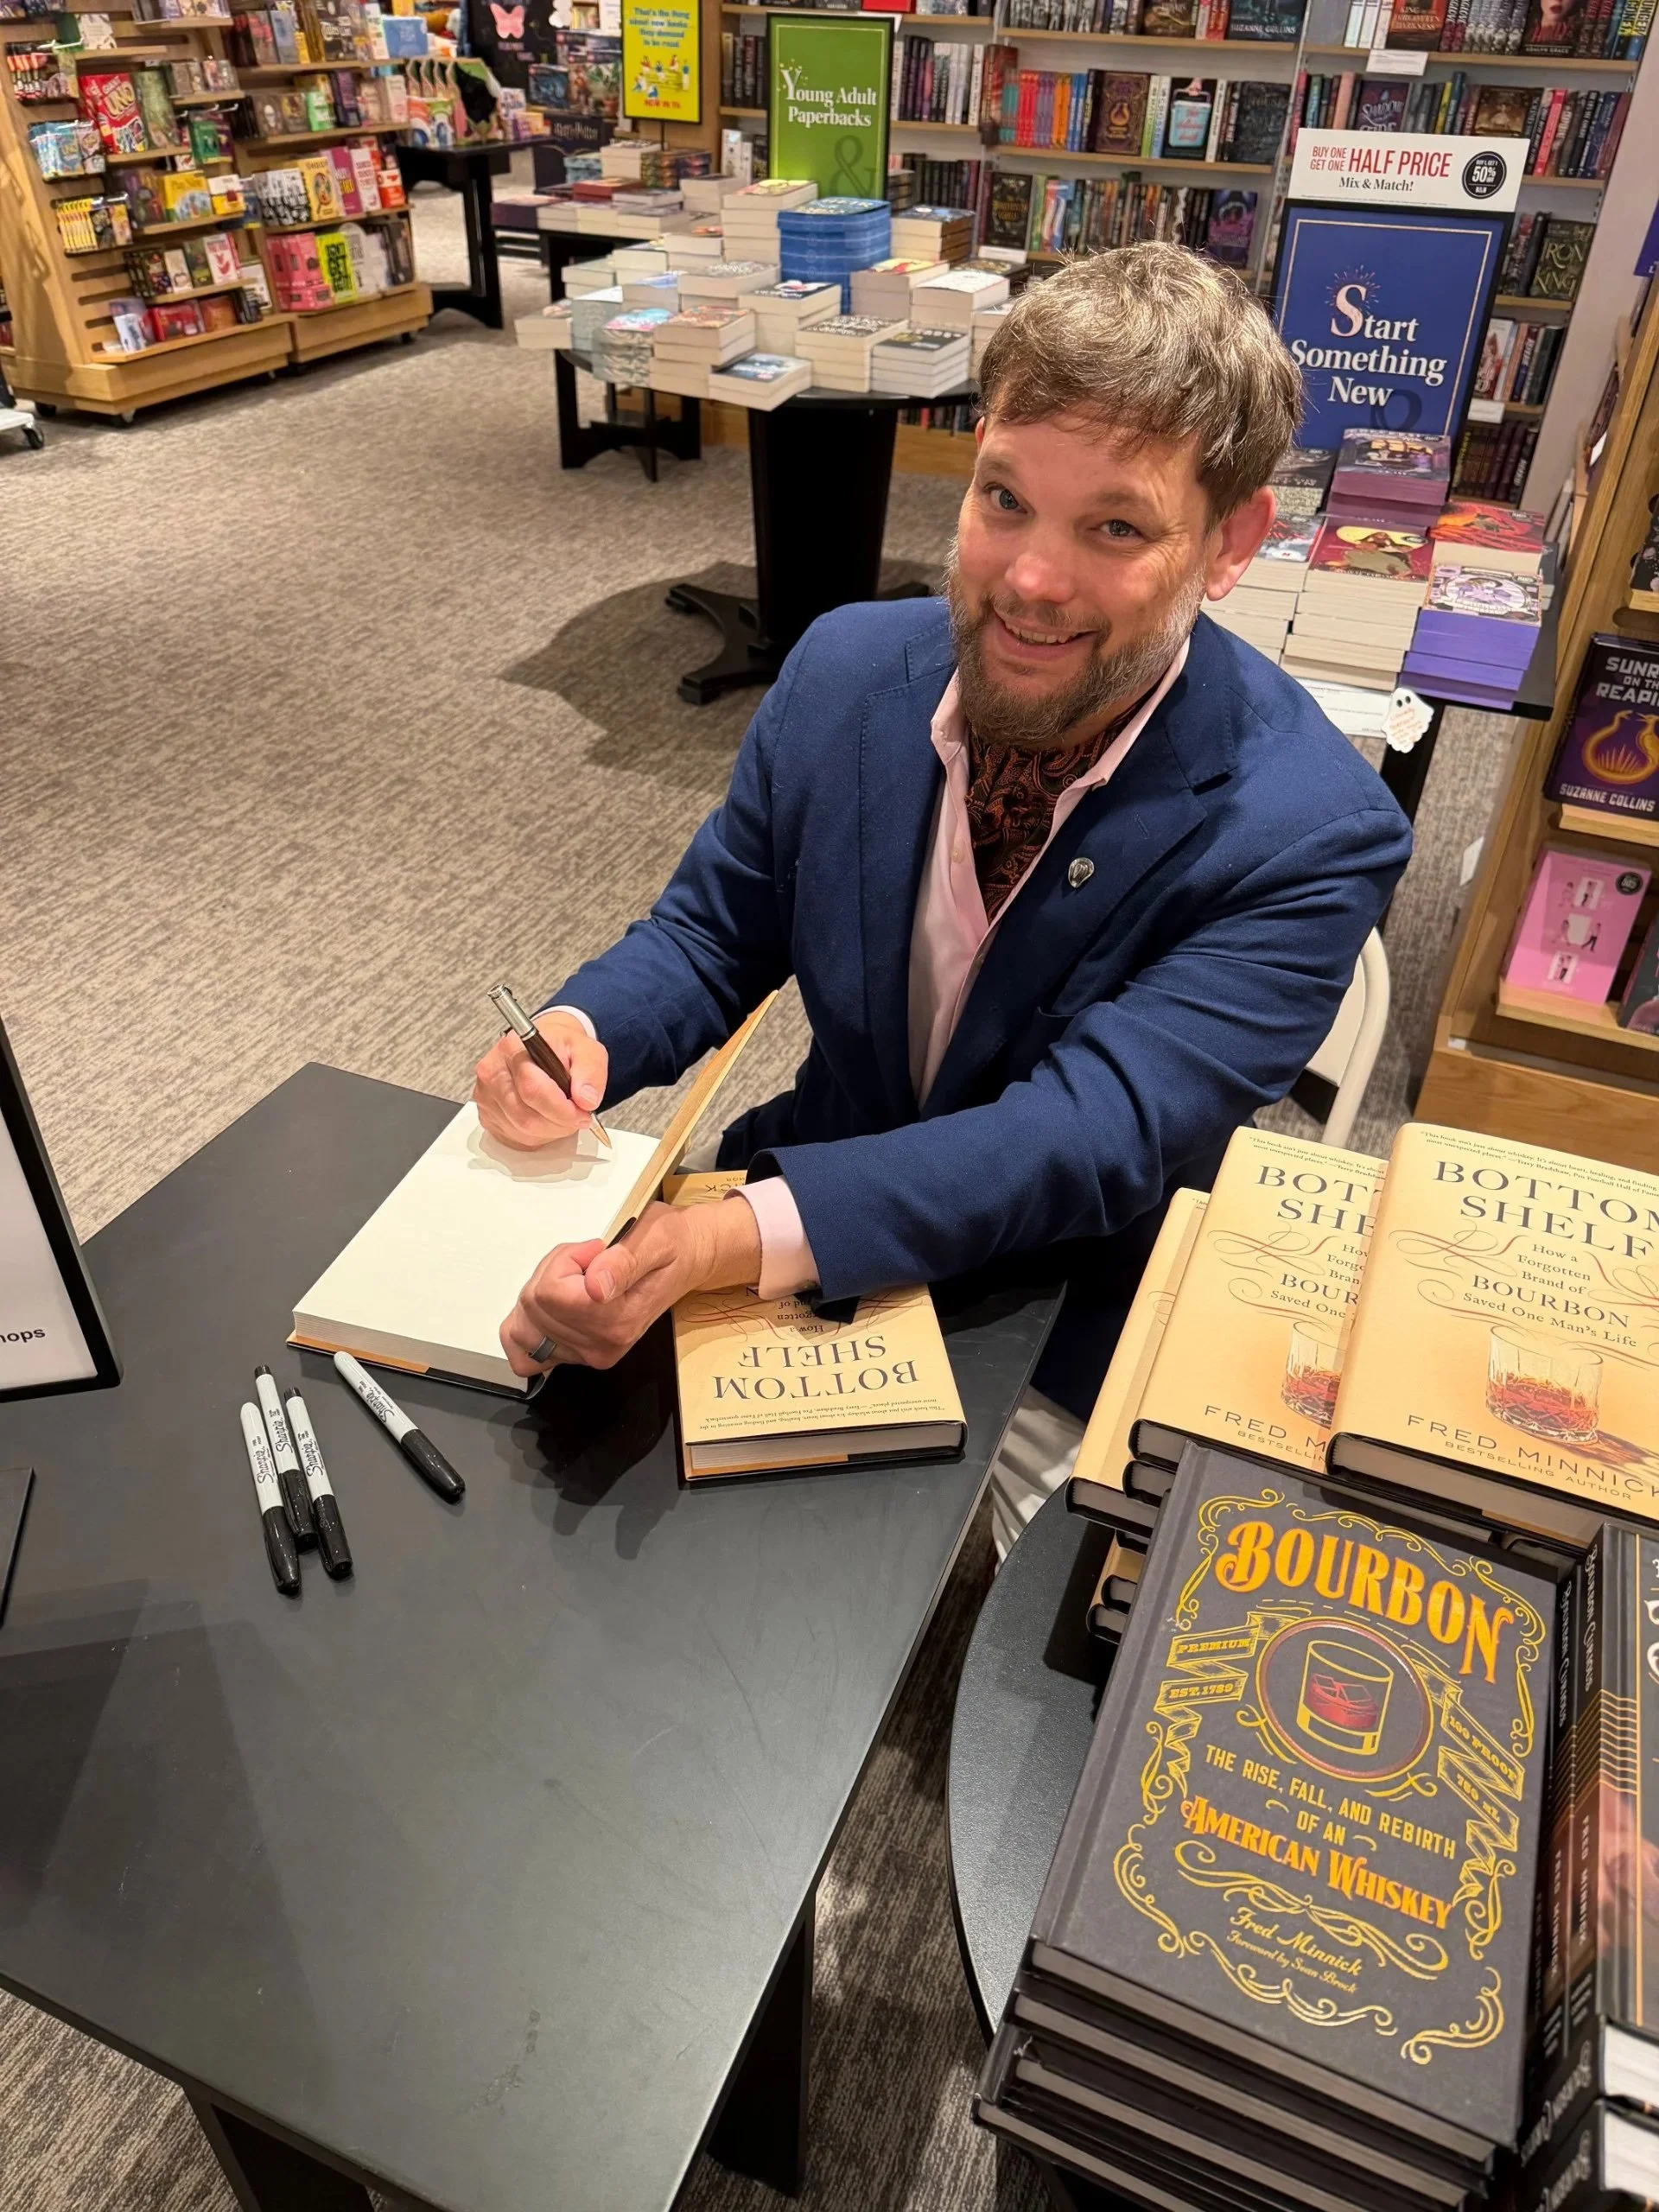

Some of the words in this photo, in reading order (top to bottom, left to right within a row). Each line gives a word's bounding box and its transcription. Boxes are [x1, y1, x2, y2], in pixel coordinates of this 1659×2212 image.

[780, 67, 834, 108] Young
[836, 86, 877, 105] Adult
[787, 105, 872, 129] Paperbacks
[1310, 158, 1326, 171] GET
[1327, 159, 1344, 172] ONE
[1313, 145, 1330, 158] BUY
[1331, 147, 1347, 159] ONE
[1348, 148, 1395, 174] HALF
[1398, 150, 1453, 178] PRICE
[1338, 175, 1360, 189] Mix
[1362, 178, 1372, 189] &
[1373, 178, 1414, 192] Match!
[1331, 283, 1420, 342] Start
[1291, 339, 1447, 387] Something
[1327, 375, 1394, 407] New
[1605, 657, 1659, 678] SUNR
[1623, 676, 1641, 687] ON
[1595, 682, 1659, 707] REAPI
[1560, 783, 1607, 804] SUZANNE
[1609, 793, 1656, 813] COLLINS
[1277, 1198, 1376, 1237] SHE
[1460, 1196, 1654, 1259] SHELF
[1517, 1254, 1591, 1281] Forgotten
[1532, 1243, 1566, 1259] How
[1522, 1271, 1564, 1290] Brand
[1569, 1286, 1586, 1294] of
[777, 1301, 791, 1310] of
[1271, 1290, 1310, 1308] Saved
[1316, 1304, 1345, 1318] One
[1472, 1274, 1629, 1328] BOURBON
[797, 1325, 824, 1334] How
[1464, 1293, 1505, 1313] Saved
[1511, 1306, 1543, 1322] One
[1550, 1317, 1597, 1337] Man's
[1603, 1332, 1637, 1347] Life
[737, 1335, 887, 1369] SHELF
[711, 1359, 920, 1400] BOTTOM
[1205, 1405, 1287, 1440] FRED
[1407, 1414, 1497, 1450] FRED
[1445, 1440, 1554, 1478] BESTSELLING
[1565, 1476, 1632, 1500] AUTHOR
[1215, 1520, 1515, 1686] BOURBON
[1177, 1637, 1251, 1655] PREMIUM
[1171, 1685, 1198, 1699] EST.
[1449, 1715, 1470, 1739] 100
[1471, 1735, 1517, 1782] PROOF
[1205, 1744, 1236, 1772] THE
[1242, 1758, 1284, 1795] RISE,
[1288, 1777, 1333, 1813] FALL,
[1338, 1797, 1372, 1826] AND
[1379, 1812, 1456, 1859] REBIRTH
[1457, 1773, 1478, 1801] 750
[1297, 1810, 1319, 1834] OF
[1323, 1822, 1346, 1847] AN
[1581, 1815, 1590, 1860] FRED
[1180, 1795, 1320, 1877] AMERICAN
[1327, 1849, 1455, 1929] WHISKEY
[1579, 1867, 1588, 1946] MINNICK
[1230, 1906, 1280, 1939] Fred
[1277, 1930, 1363, 1976] Minnick
[1227, 1930, 1278, 1960] Foreword
[1278, 1953, 1291, 1968] by
[1292, 1957, 1319, 1978] Sean
[1319, 1970, 1357, 1993] Brock
